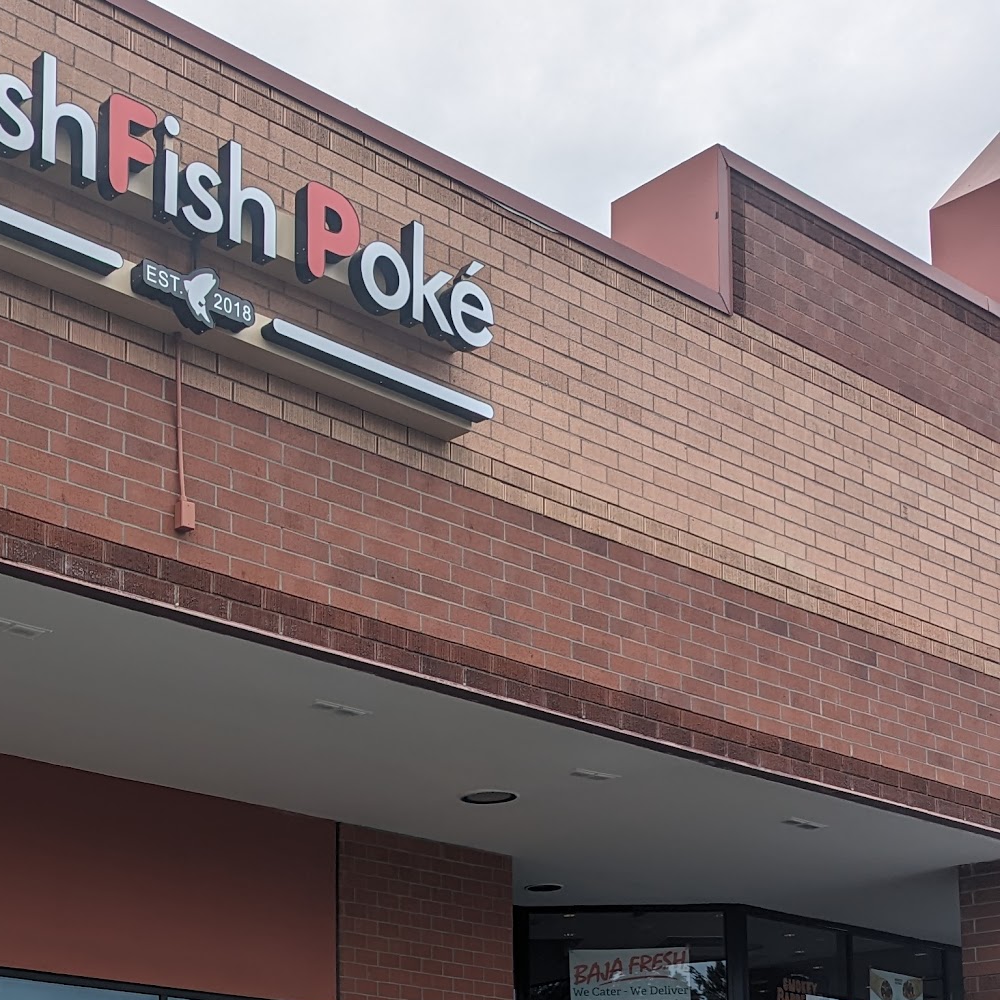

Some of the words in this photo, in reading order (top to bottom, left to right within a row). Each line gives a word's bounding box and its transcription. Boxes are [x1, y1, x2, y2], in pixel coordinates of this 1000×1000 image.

[304, 181, 495, 348] Poké
[146, 264, 184, 295] EST.
[213, 293, 252, 322] 2018
[572, 987, 590, 997] We
[592, 987, 621, 997] Cater
[630, 986, 647, 996] We
[650, 985, 689, 996] Deliver
[573, 957, 623, 985] BAJA
[628, 951, 687, 975] FRESH
